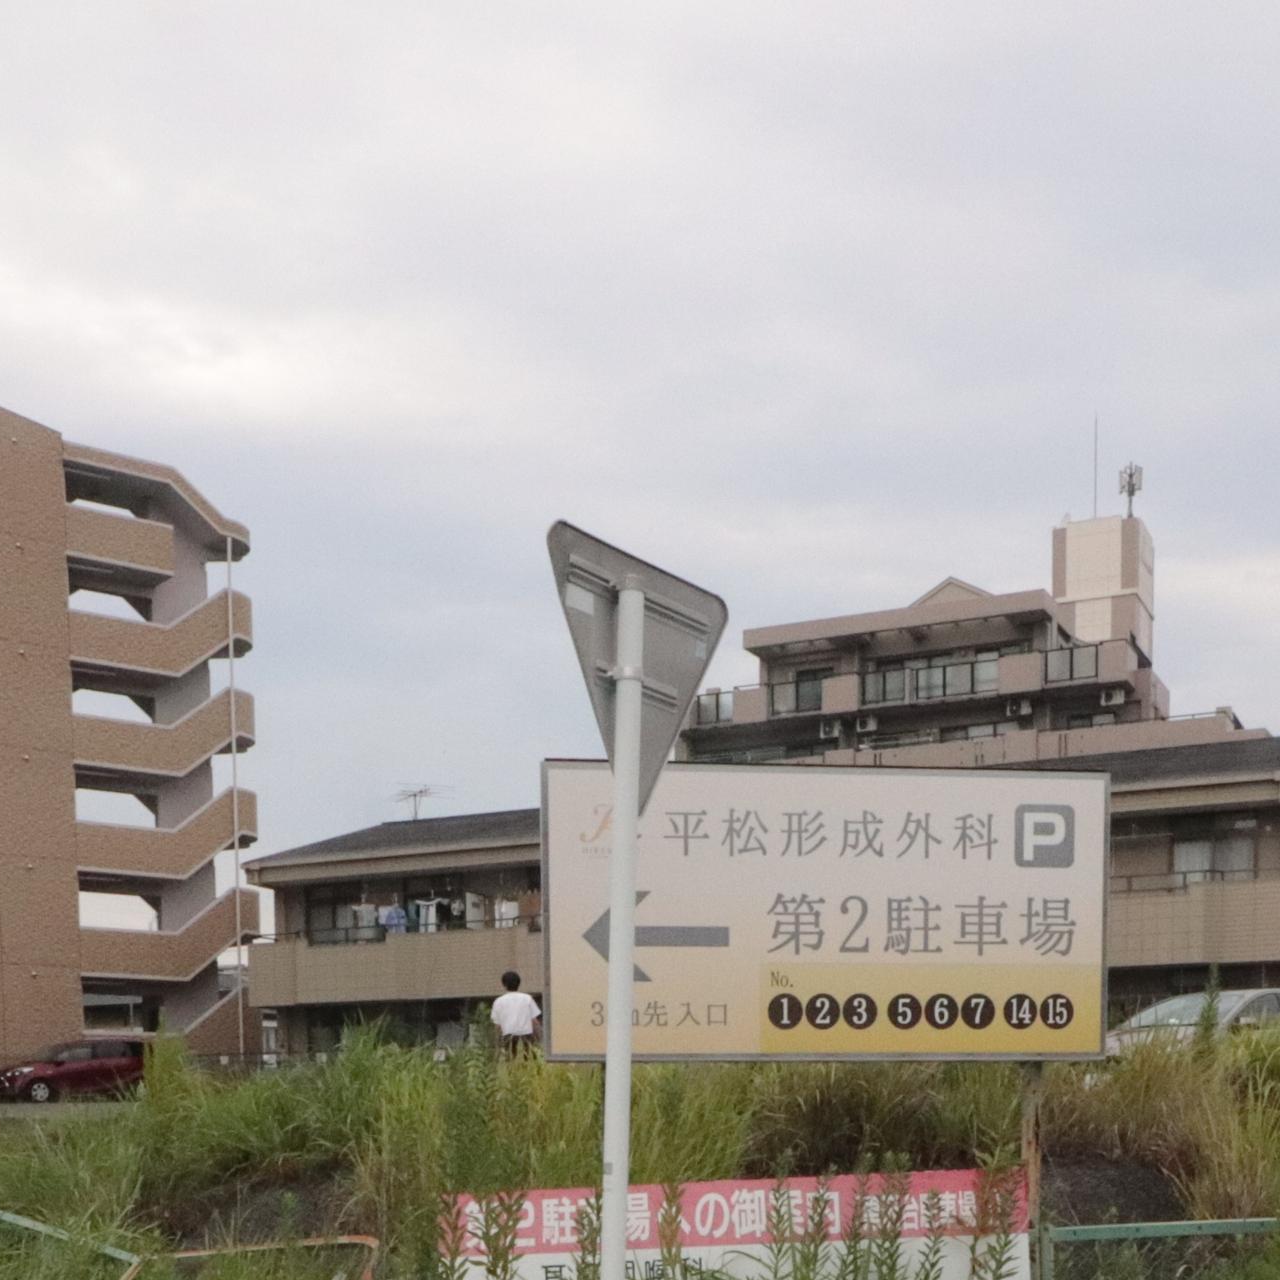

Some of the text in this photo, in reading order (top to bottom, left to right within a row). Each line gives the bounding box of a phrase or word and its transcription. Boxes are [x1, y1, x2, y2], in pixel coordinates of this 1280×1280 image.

[662, 808, 1000, 862] 平松形成外科
[1022, 811, 1067, 863] P
[765, 892, 1077, 959] 第2駐車場
[770, 971, 794, 988] No.
